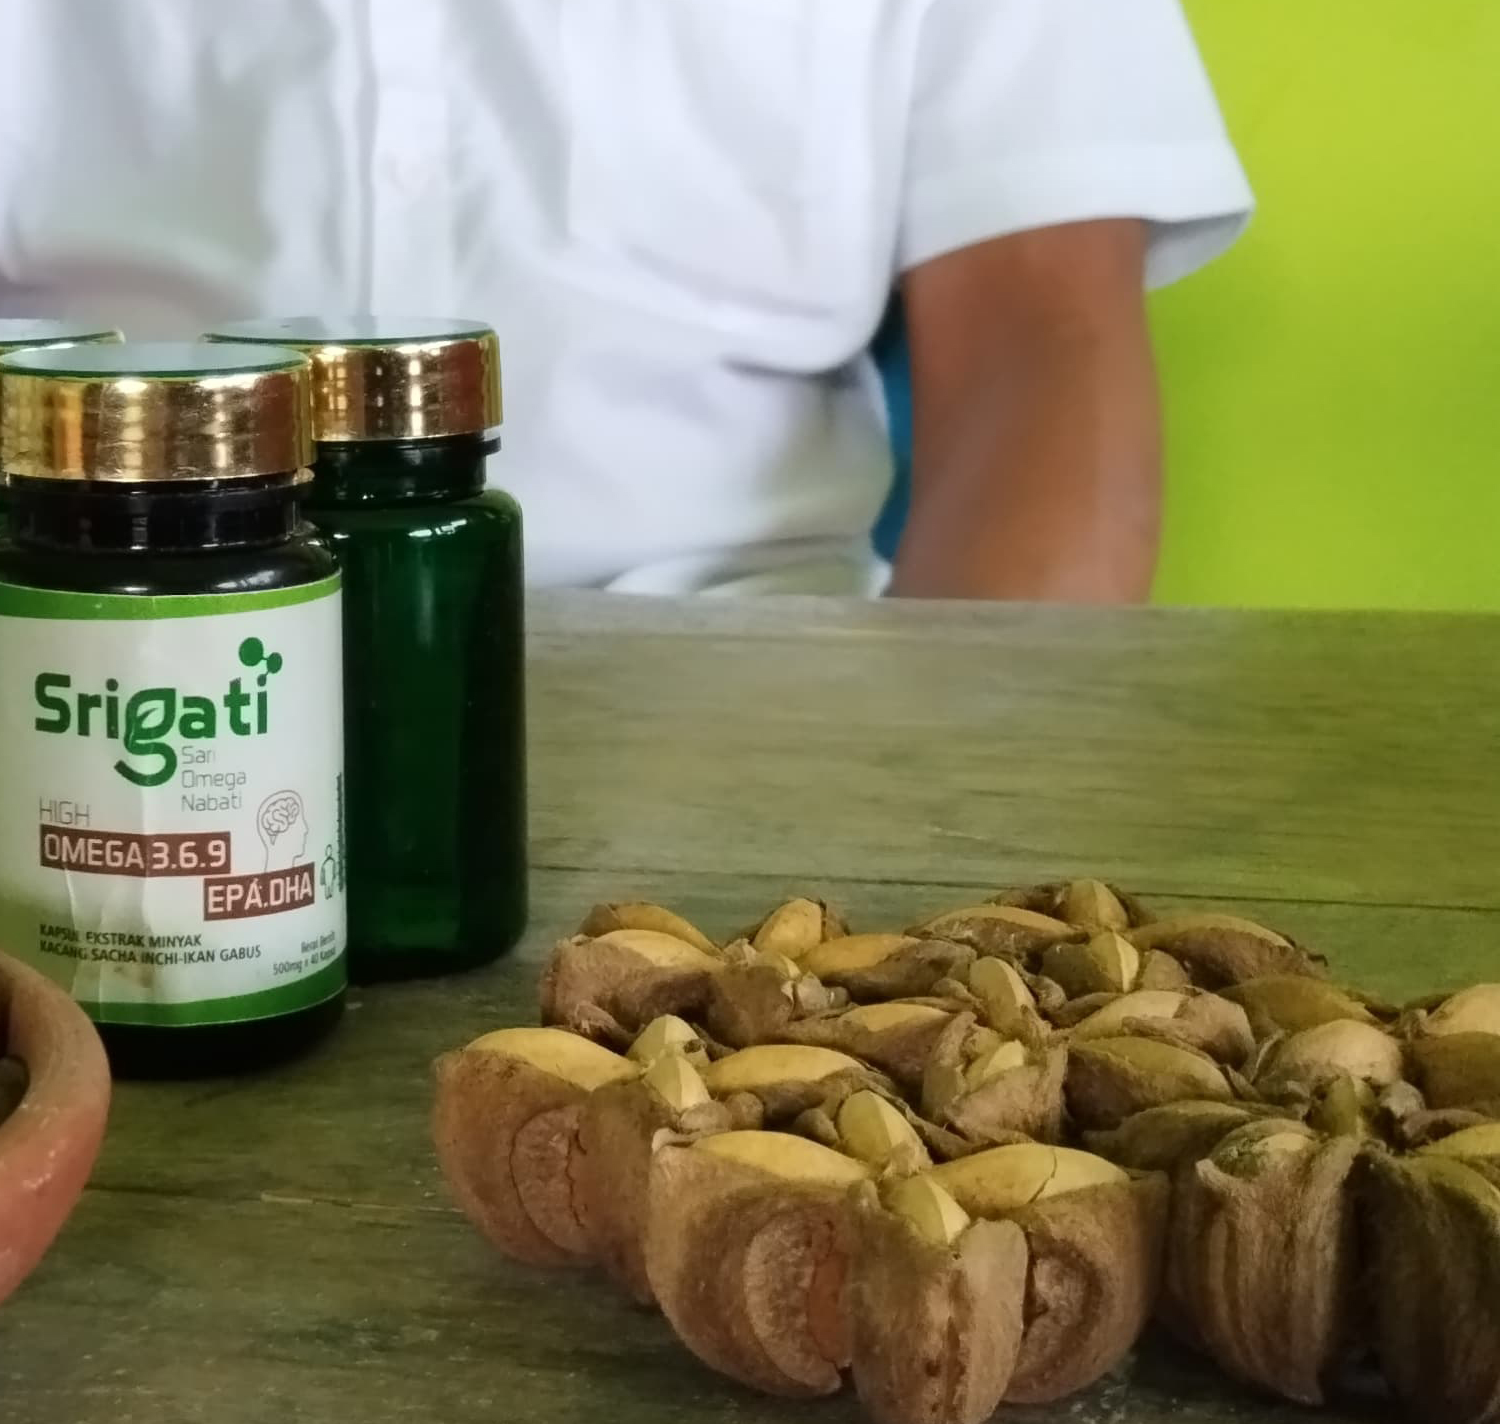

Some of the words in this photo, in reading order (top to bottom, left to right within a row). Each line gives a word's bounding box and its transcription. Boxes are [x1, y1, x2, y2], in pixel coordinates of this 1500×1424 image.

[34, 672, 268, 786] Srigati
[181, 745, 216, 765] Sari
[181, 769, 247, 790] Omega
[39, 796, 90, 826] HIGH
[181, 792, 242, 812] Nabati
[44, 833, 145, 869] OMEGA
[151, 839, 227, 870] 3.6.9
[207, 872, 313, 913] EPA.DHA
[40, 924, 79, 942] KAPSUL
[86, 931, 145, 947] EKSTRAK
[149, 934, 202, 948] MINYAK
[40, 940, 88, 960] KACANG
[91, 947, 137, 963] SACHA
[141, 949, 215, 965] INCHI-IKAN
[219, 944, 262, 961] GABUS
